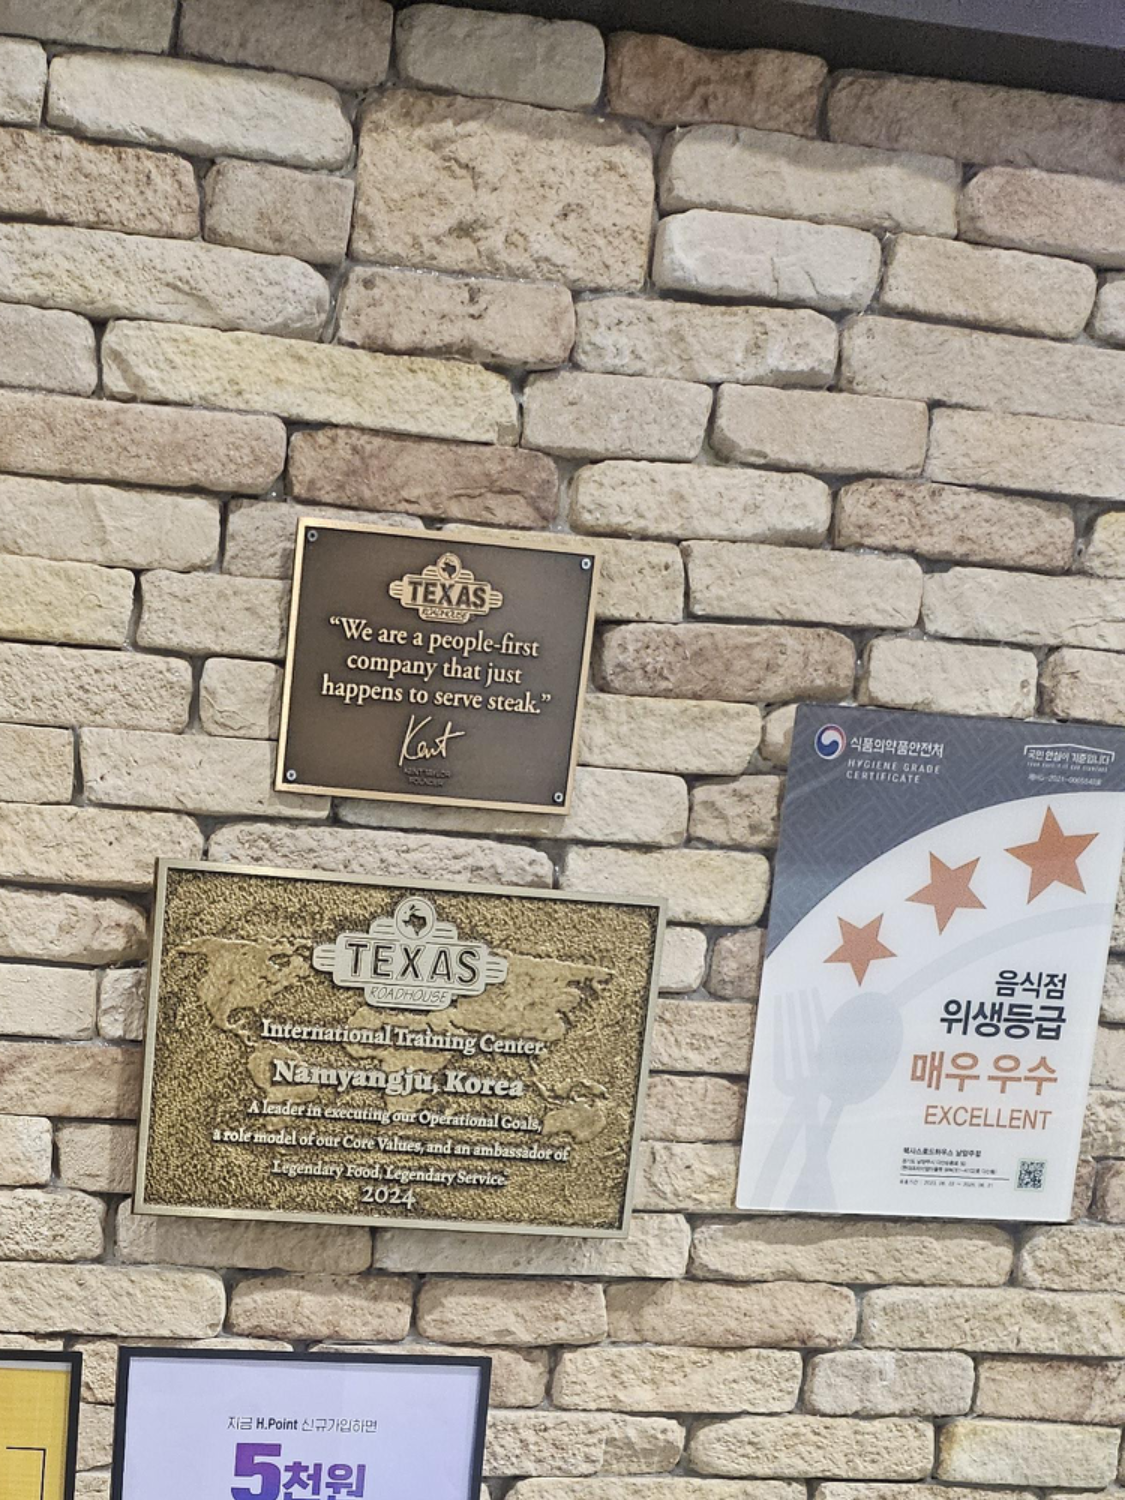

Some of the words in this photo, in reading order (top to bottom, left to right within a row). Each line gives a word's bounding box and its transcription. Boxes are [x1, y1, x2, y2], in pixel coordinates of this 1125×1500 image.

[408, 580, 486, 609] TEXAS
[378, 628, 408, 645] are
[413, 632, 423, 645] a
[428, 631, 539, 657] people-first
[347, 653, 437, 681] company
[443, 659, 481, 680] that
[486, 663, 522, 686] just
[321, 674, 402, 705] happens
[409, 687, 429, 704] to
[435, 689, 483, 708] serve
[398, 715, 465, 766] Kent
[850, 737, 944, 758] 식품의약품안전처
[845, 770, 921, 784] CERTIFICATE
[847, 759, 898, 772] HYGIENE
[903, 762, 941, 774] GRADE
[345, 941, 480, 986] TEXAS
[369, 986, 448, 1004] ROADHOUSE
[995, 969, 1068, 1001] 음식점
[940, 1000, 1068, 1040] 위생등급
[261, 1020, 392, 1045] International
[396, 1028, 477, 1055] Training
[273, 1059, 439, 1096] Namyangju,
[444, 1071, 525, 1098] Korea
[911, 1051, 979, 1093] 매우
[988, 1054, 1059, 1096] 우수
[248, 1101, 260, 1115] A
[262, 1100, 305, 1118] leader
[308, 1103, 322, 1118] in
[325, 1106, 390, 1126] executing
[393, 1110, 416, 1124] our
[419, 1110, 498, 1131] Operational
[501, 1115, 542, 1134] Goals,
[924, 1105, 1052, 1131] EXCELLENT
[213, 1131, 221, 1143] a
[223, 1129, 252, 1144] role
[254, 1130, 296, 1147] model
[299, 1131, 314, 1147] of
[316, 1136, 340, 1149] our
[343, 1134, 375, 1150] Core
[377, 1136, 424, 1155] Values,
[427, 1140, 452, 1156] and
[454, 1144, 470, 1157] an
[473, 1143, 549, 1160] ambassador
[551, 1145, 570, 1161] of
[272, 1160, 343, 1179] Legendary
[346, 1163, 382, 1180] Food,
[386, 1166, 455, 1187] Legendary
[361, 1186, 416, 1210] 2024
[227, 1416, 252, 1431] 지금
[256, 1418, 298, 1431] H.Point
[301, 1418, 377, 1433] 신규가입하면
